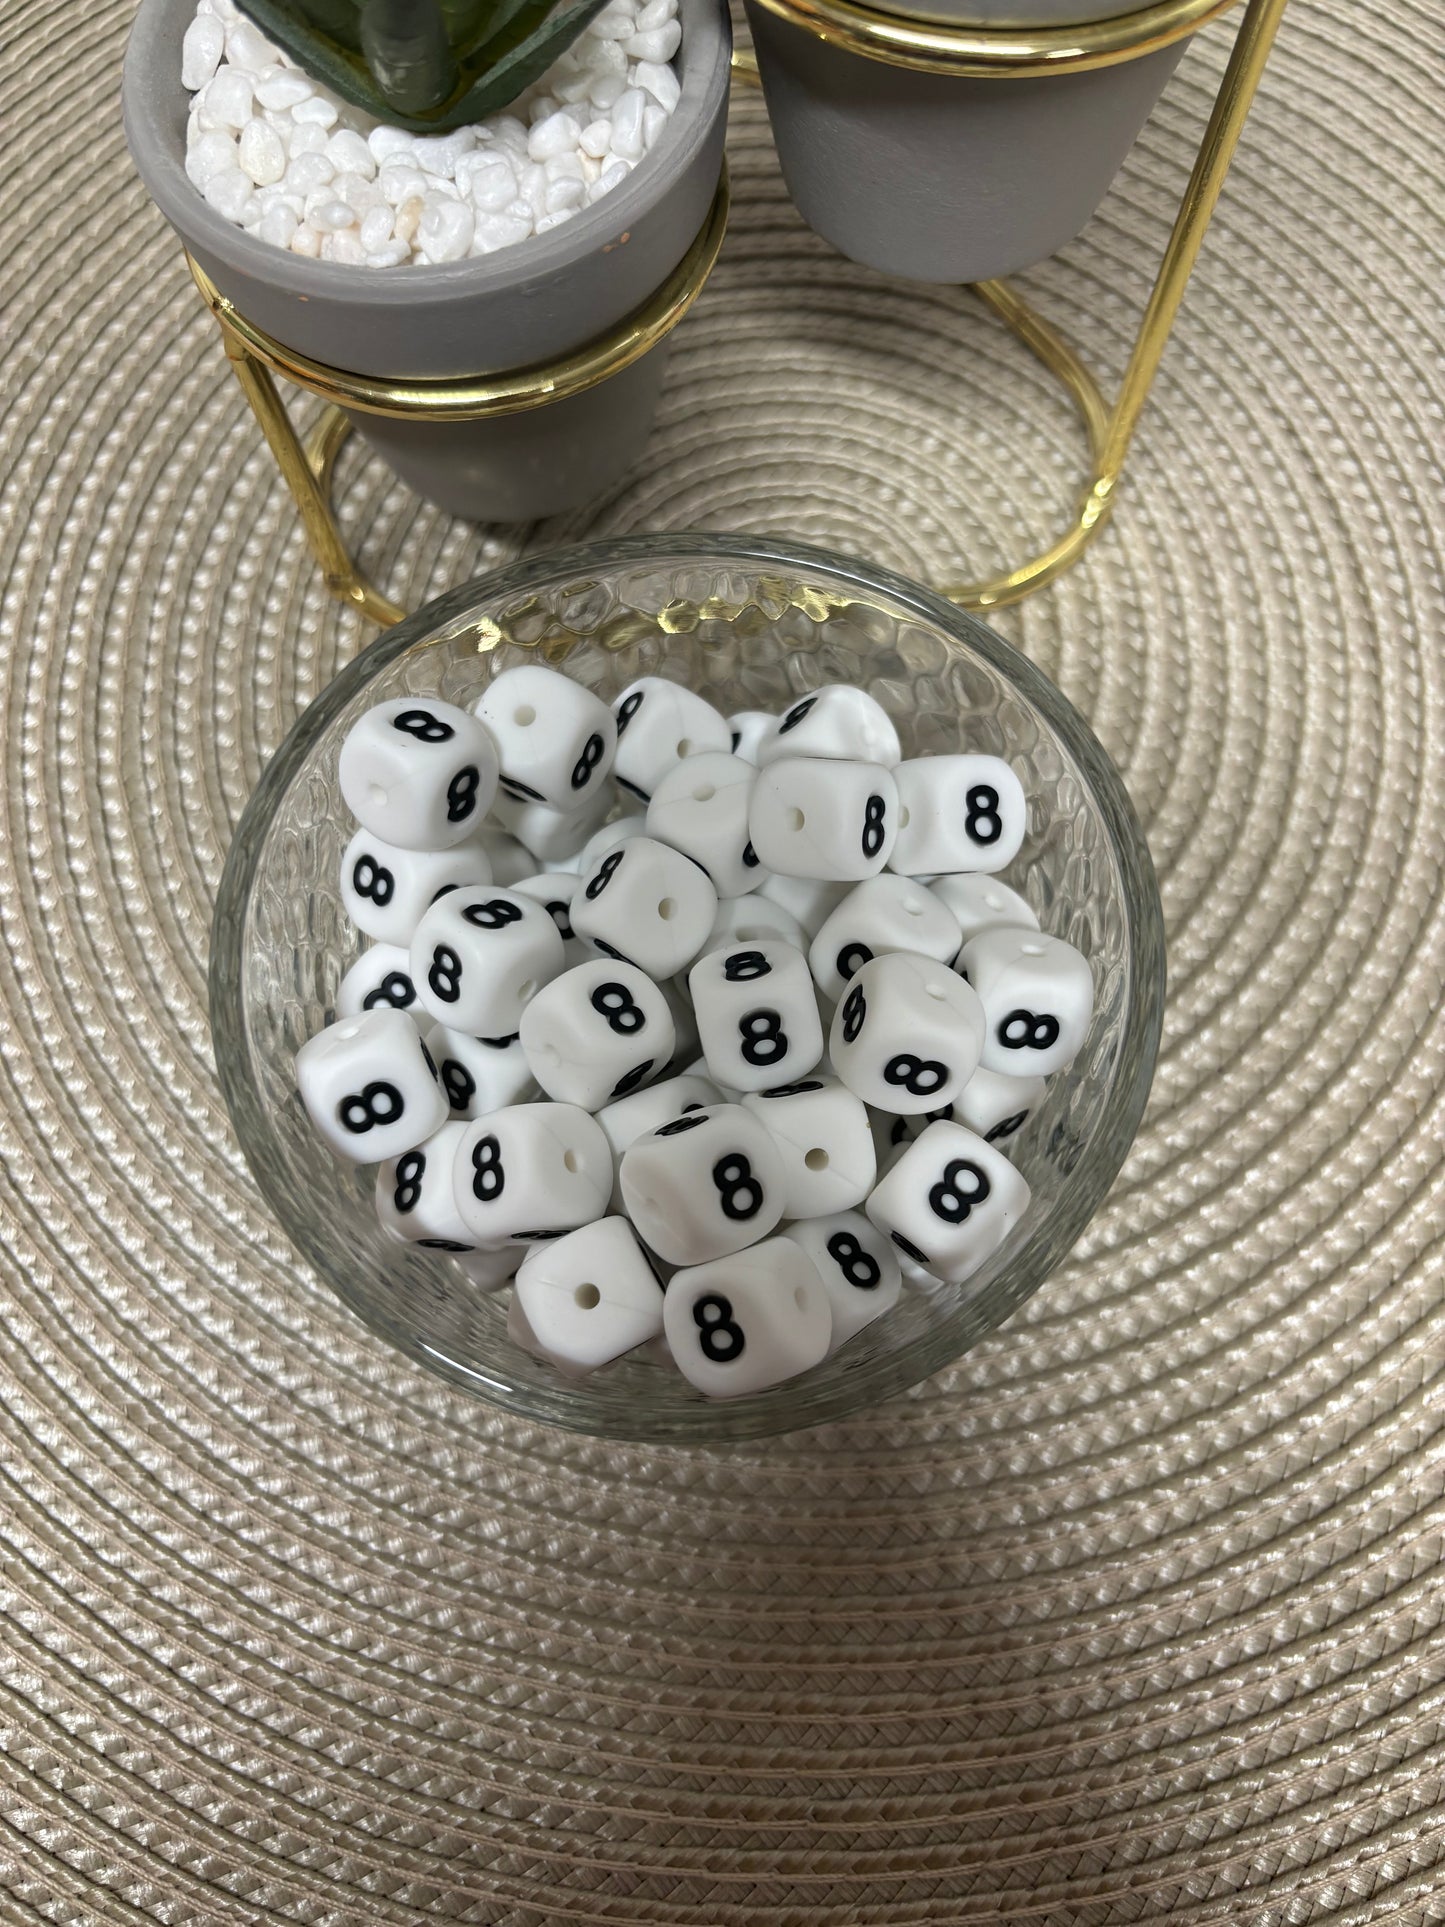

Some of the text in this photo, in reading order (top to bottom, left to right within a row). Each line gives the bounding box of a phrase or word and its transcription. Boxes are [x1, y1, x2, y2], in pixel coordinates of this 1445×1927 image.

[394, 710, 455, 743] 8
[571, 733, 604, 791] 8
[448, 765, 479, 822] 8
[965, 785, 1003, 846] 8
[862, 795, 885, 858] 8
[353, 854, 395, 907] 8
[586, 850, 625, 900] 8
[462, 900, 522, 929] 8
[364, 971, 416, 1011] 8
[429, 945, 462, 1003] 8
[591, 983, 645, 1035] 8
[739, 1007, 788, 1066] 8
[998, 1009, 1060, 1050] 8
[884, 1054, 949, 1096] 8
[339, 1081, 404, 1133] 8
[394, 1150, 426, 1215] 8
[472, 1135, 504, 1201] 8
[712, 1153, 764, 1222] 8
[929, 1159, 991, 1224] 8
[827, 1231, 881, 1291] 8
[692, 1293, 746, 1363] 8
